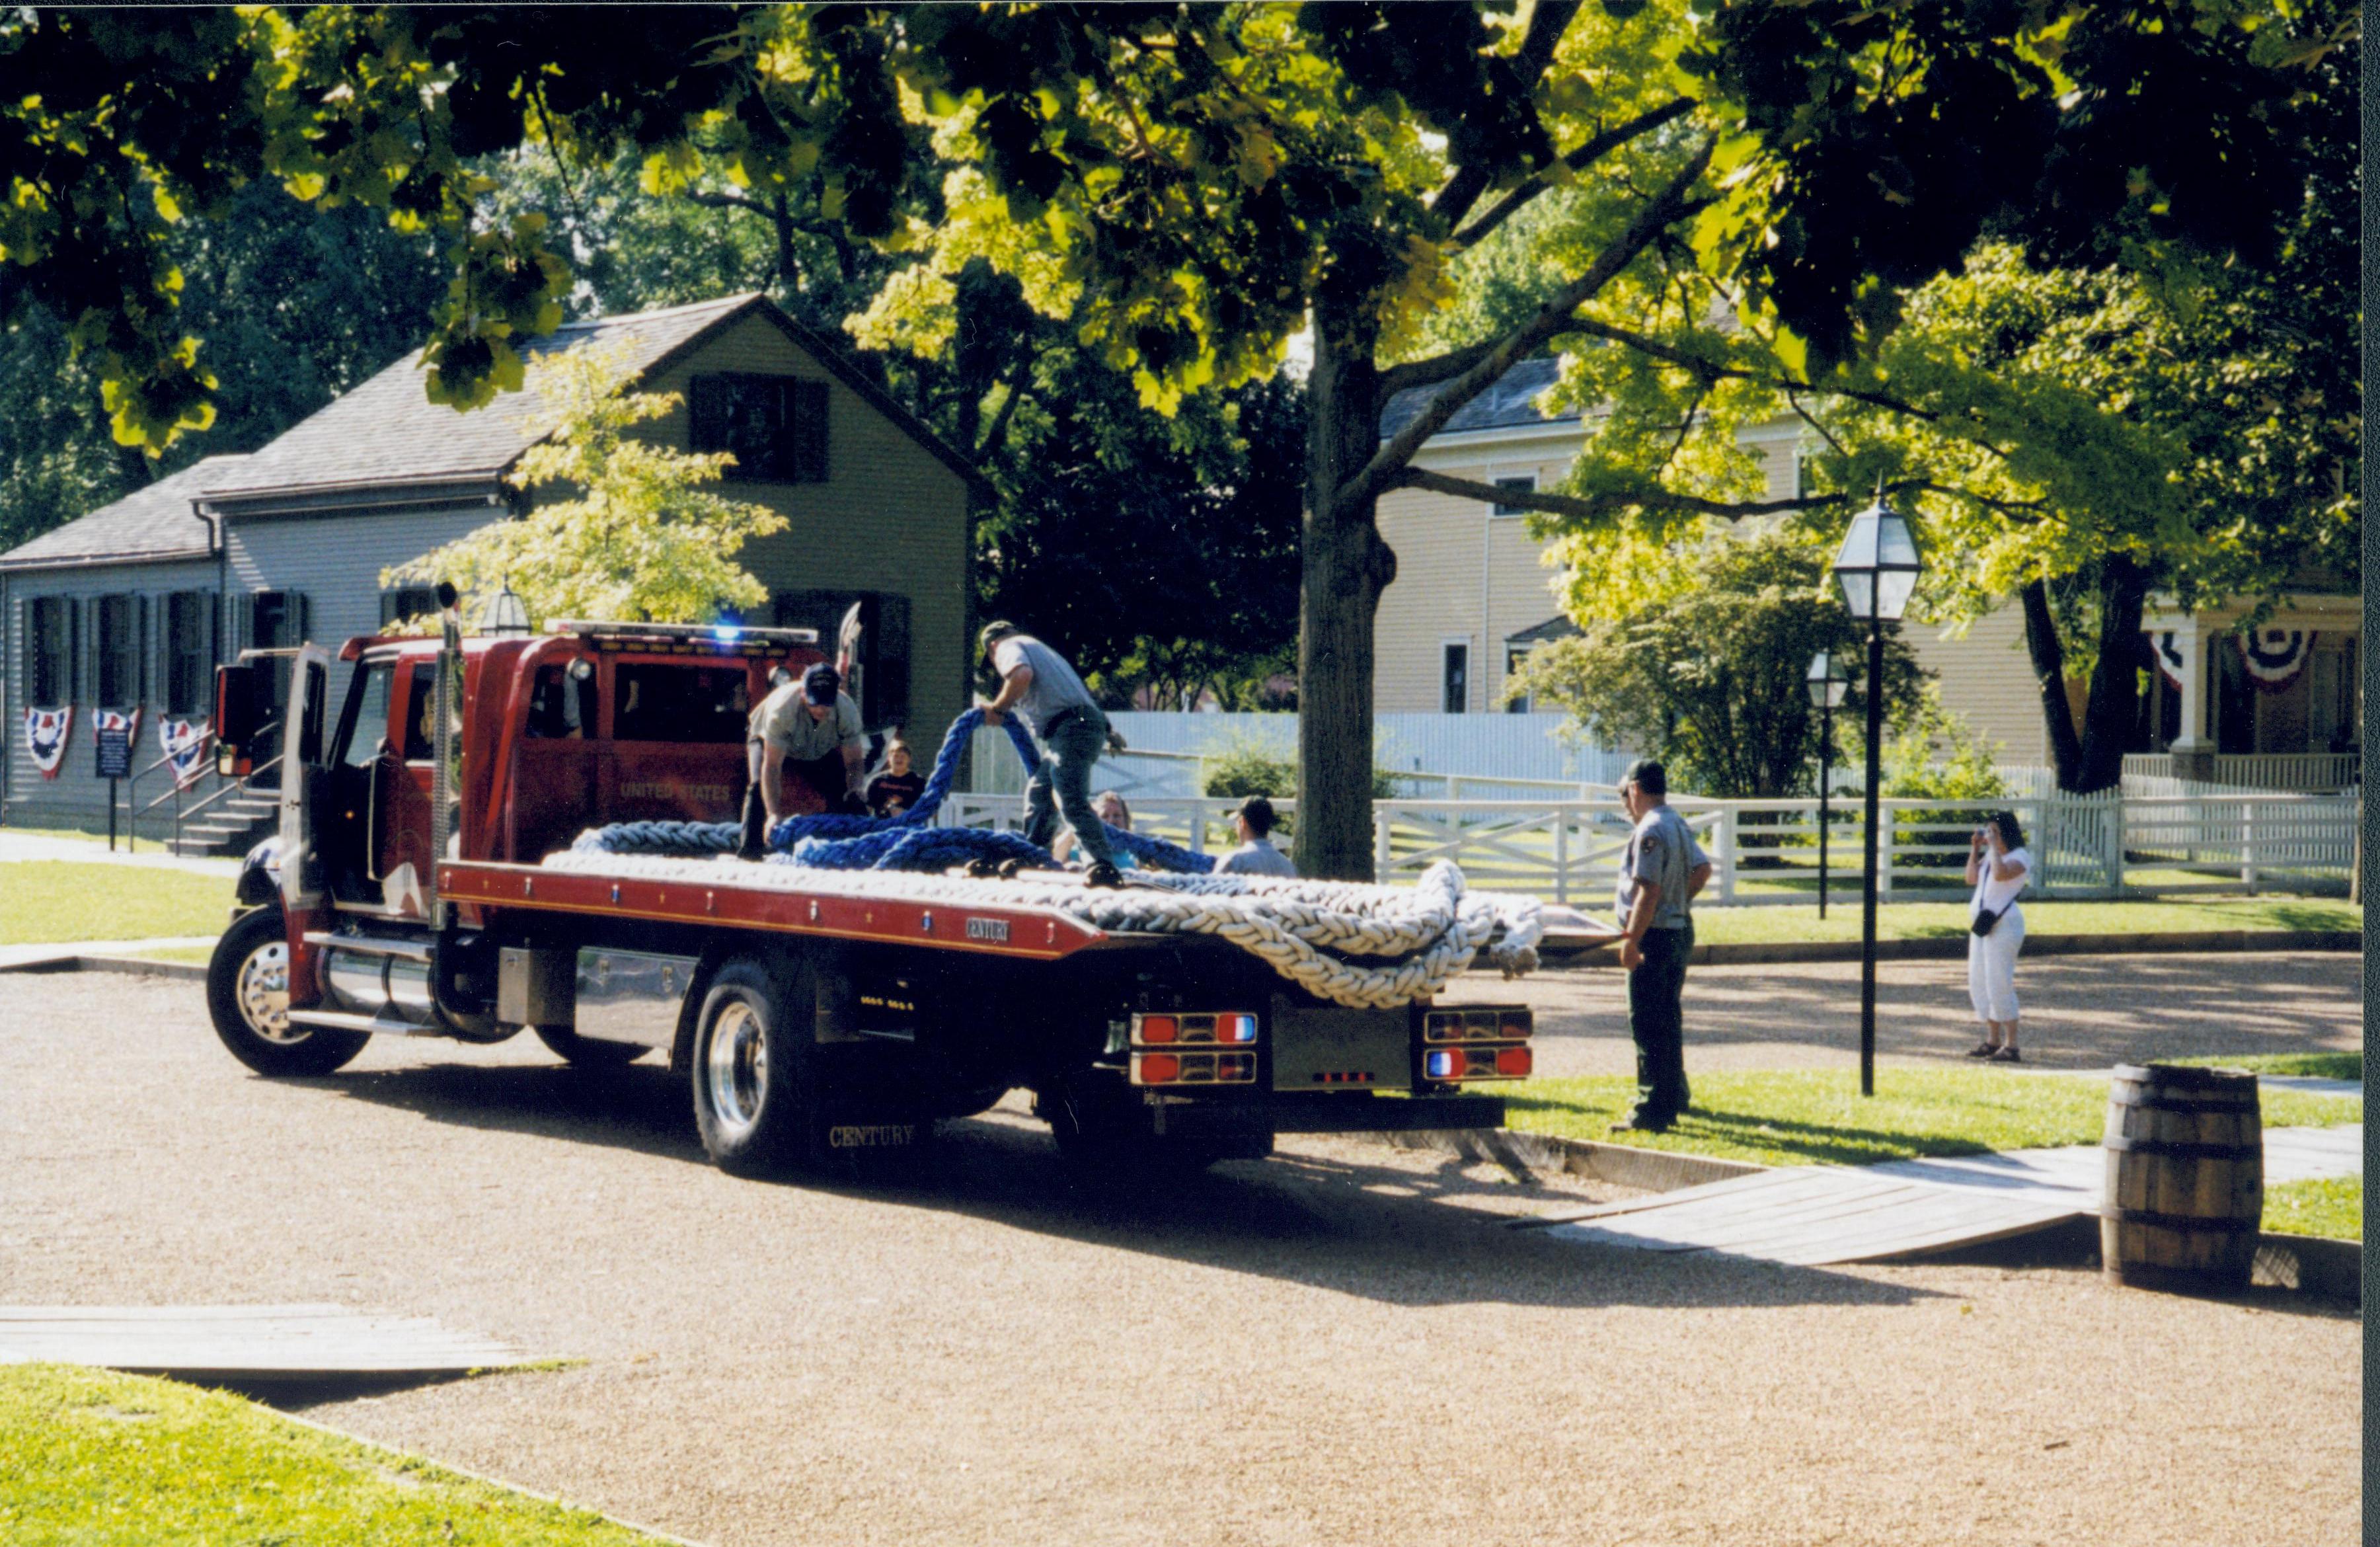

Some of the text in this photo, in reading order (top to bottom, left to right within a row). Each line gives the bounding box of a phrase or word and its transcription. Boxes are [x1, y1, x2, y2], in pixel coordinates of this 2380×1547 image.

[621, 782, 730, 801] UNITED STATES
[966, 917, 1010, 941] CENTURY
[829, 1125, 915, 1148] CENTURY
